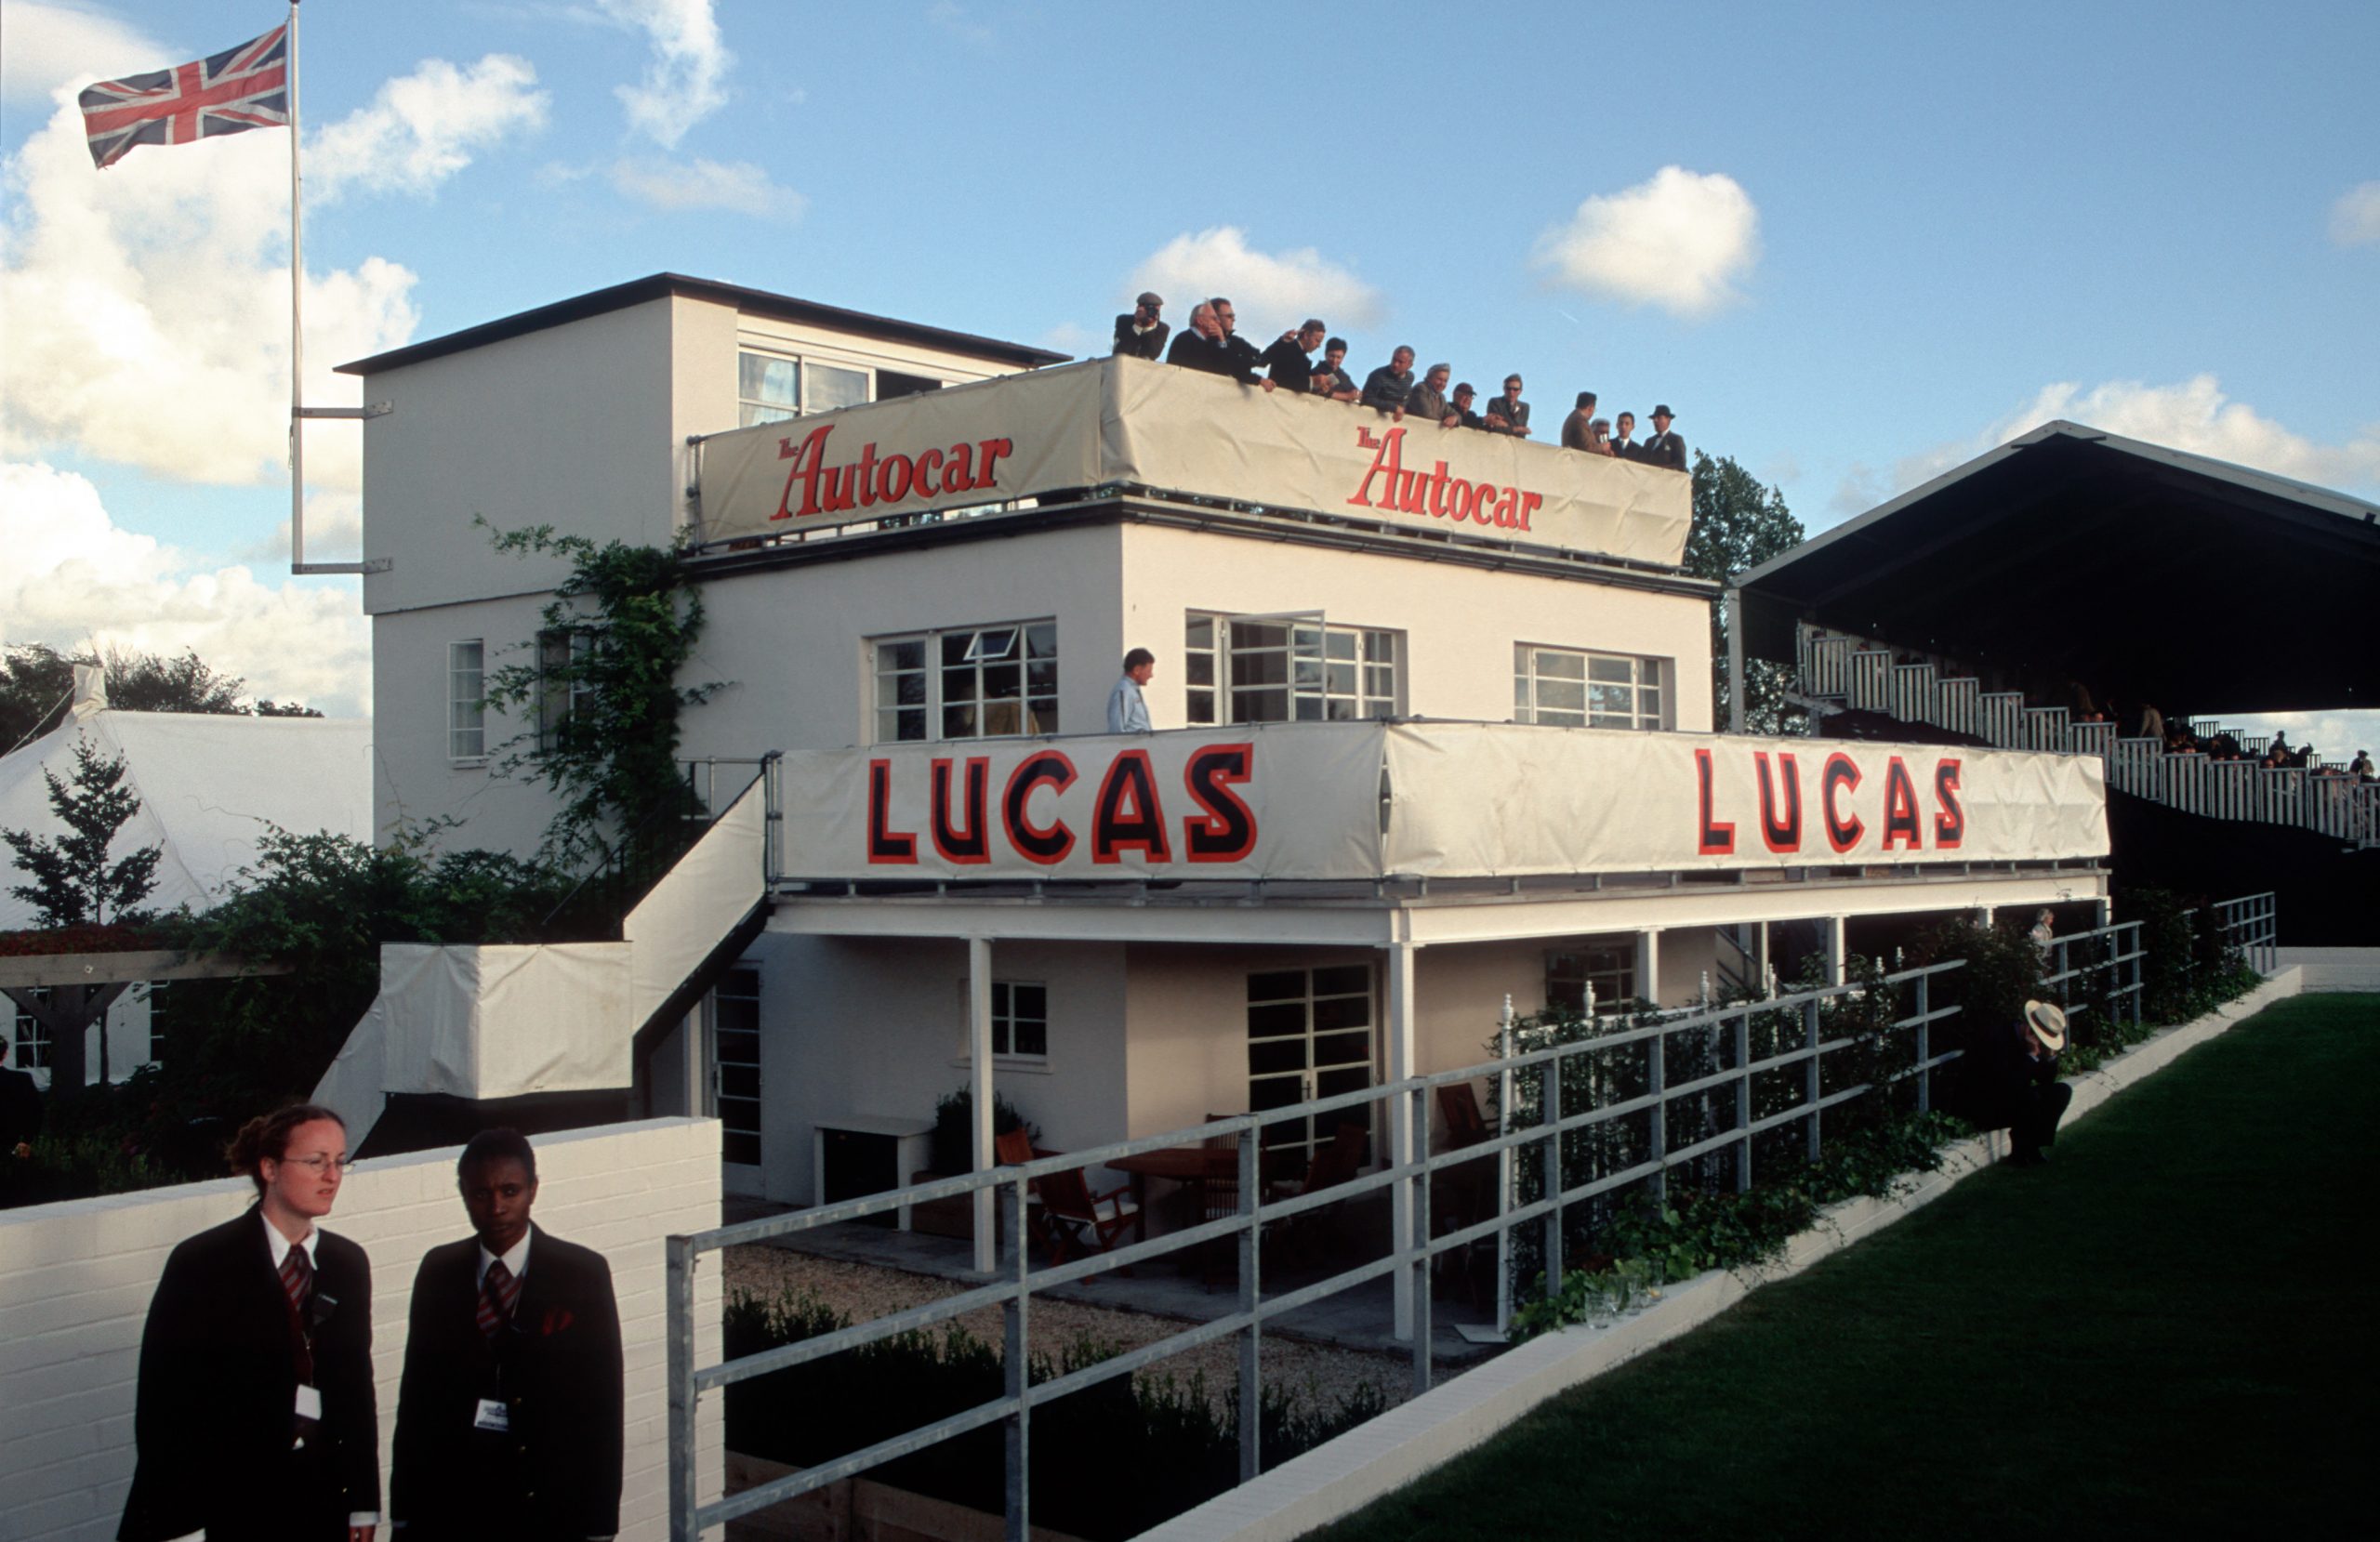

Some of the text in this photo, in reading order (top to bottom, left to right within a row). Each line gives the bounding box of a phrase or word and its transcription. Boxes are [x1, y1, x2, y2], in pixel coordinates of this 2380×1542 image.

[769, 425, 1012, 521] The Autocar
[1347, 427, 1542, 532] The Autocar
[867, 743, 1257, 865] LUCAS
[1695, 748, 1964, 855] LUCAS
